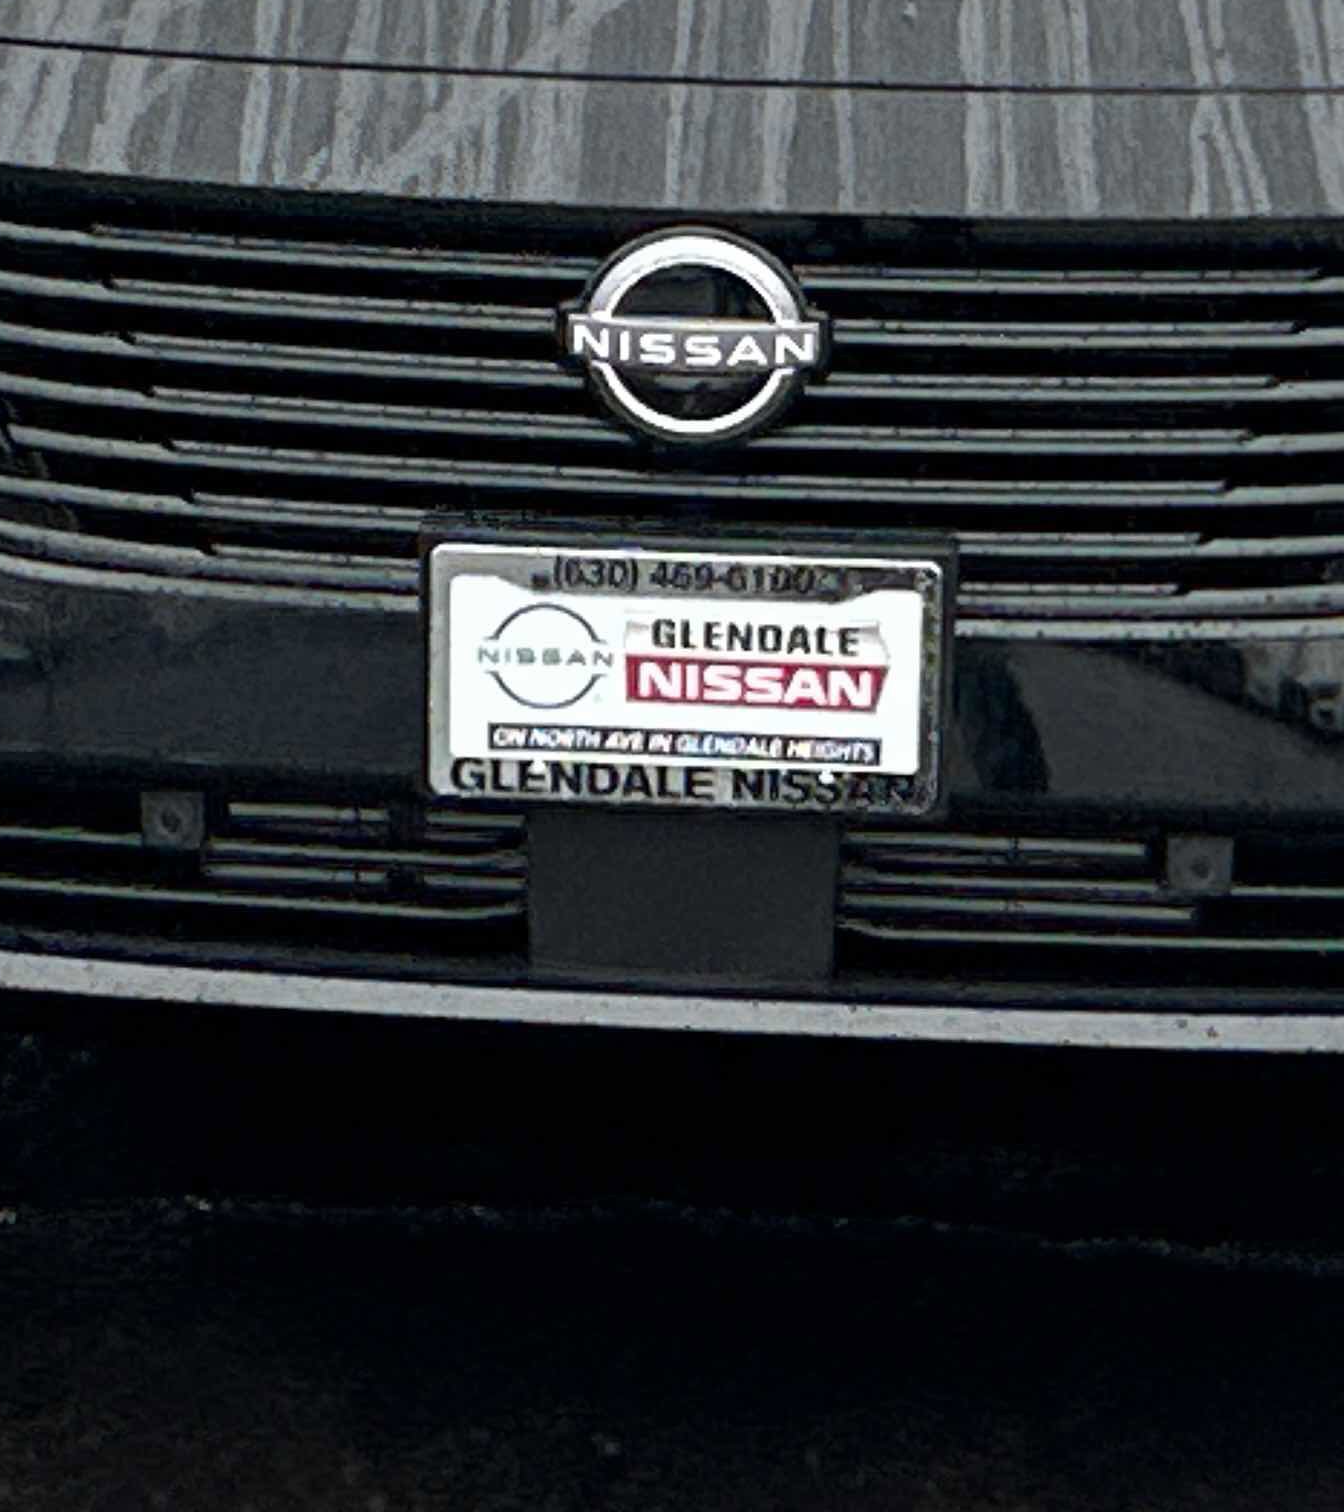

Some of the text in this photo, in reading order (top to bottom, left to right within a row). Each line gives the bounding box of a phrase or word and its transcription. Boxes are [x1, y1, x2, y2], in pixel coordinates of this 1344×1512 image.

[572, 324, 815, 366] NISSAN
[555, 555, 638, 591] (630)
[652, 618, 860, 657] GLENDALE
[476, 647, 613, 668] NISSAN
[638, 661, 874, 707] NISSAN
[493, 726, 526, 747] ON
[528, 727, 601, 749] NORTH
[676, 733, 782, 758] GLENDALE
[785, 738, 874, 763] HEIGHTS
[450, 756, 716, 800] GLENDALE
